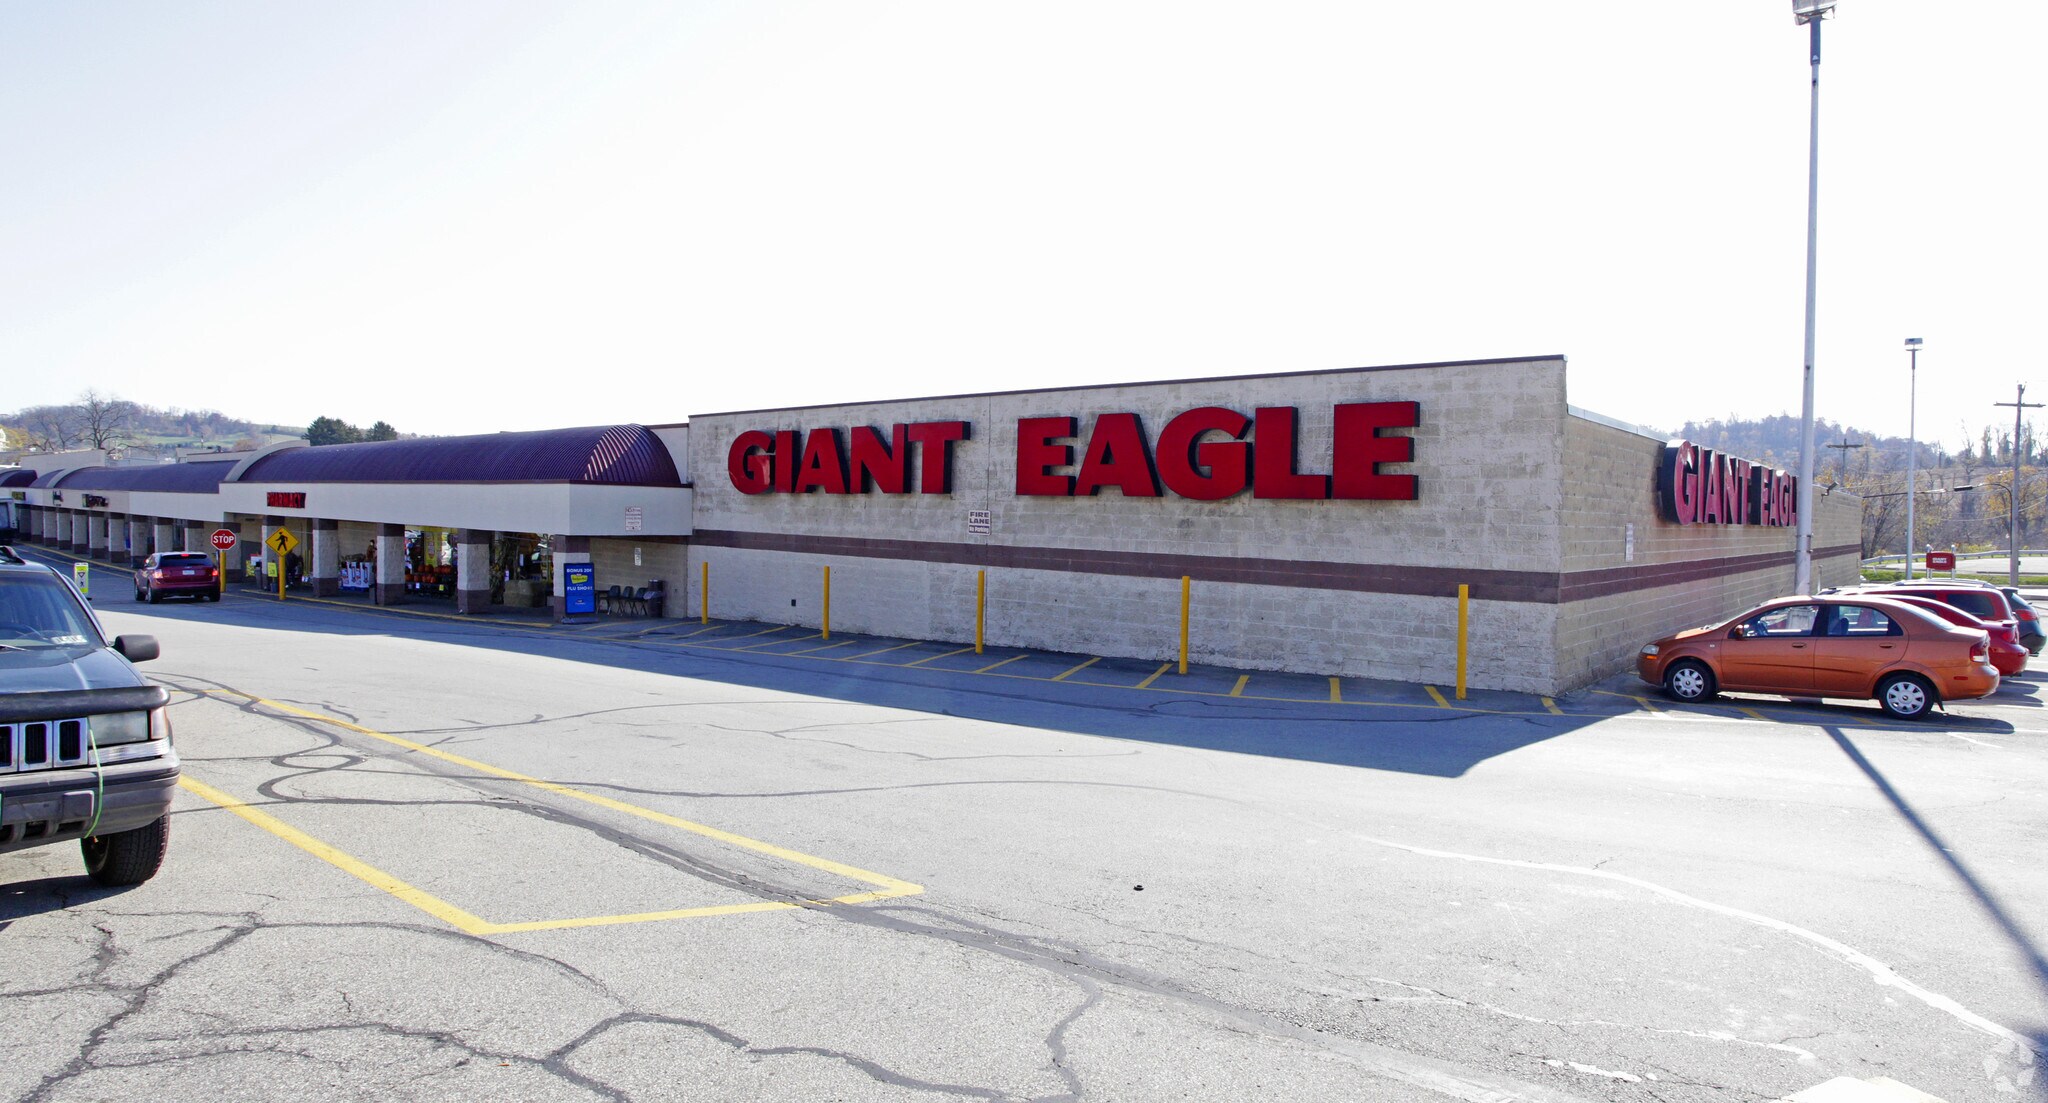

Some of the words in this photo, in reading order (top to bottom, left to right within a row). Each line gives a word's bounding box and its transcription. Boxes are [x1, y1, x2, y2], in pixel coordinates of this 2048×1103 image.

[728, 421, 970, 495] GIANT
[1016, 401, 1420, 501] EAGLE
[1674, 440, 1751, 525] GIANT
[1760, 469, 1797, 526] EAGL
[213, 535, 235, 544] STOP
